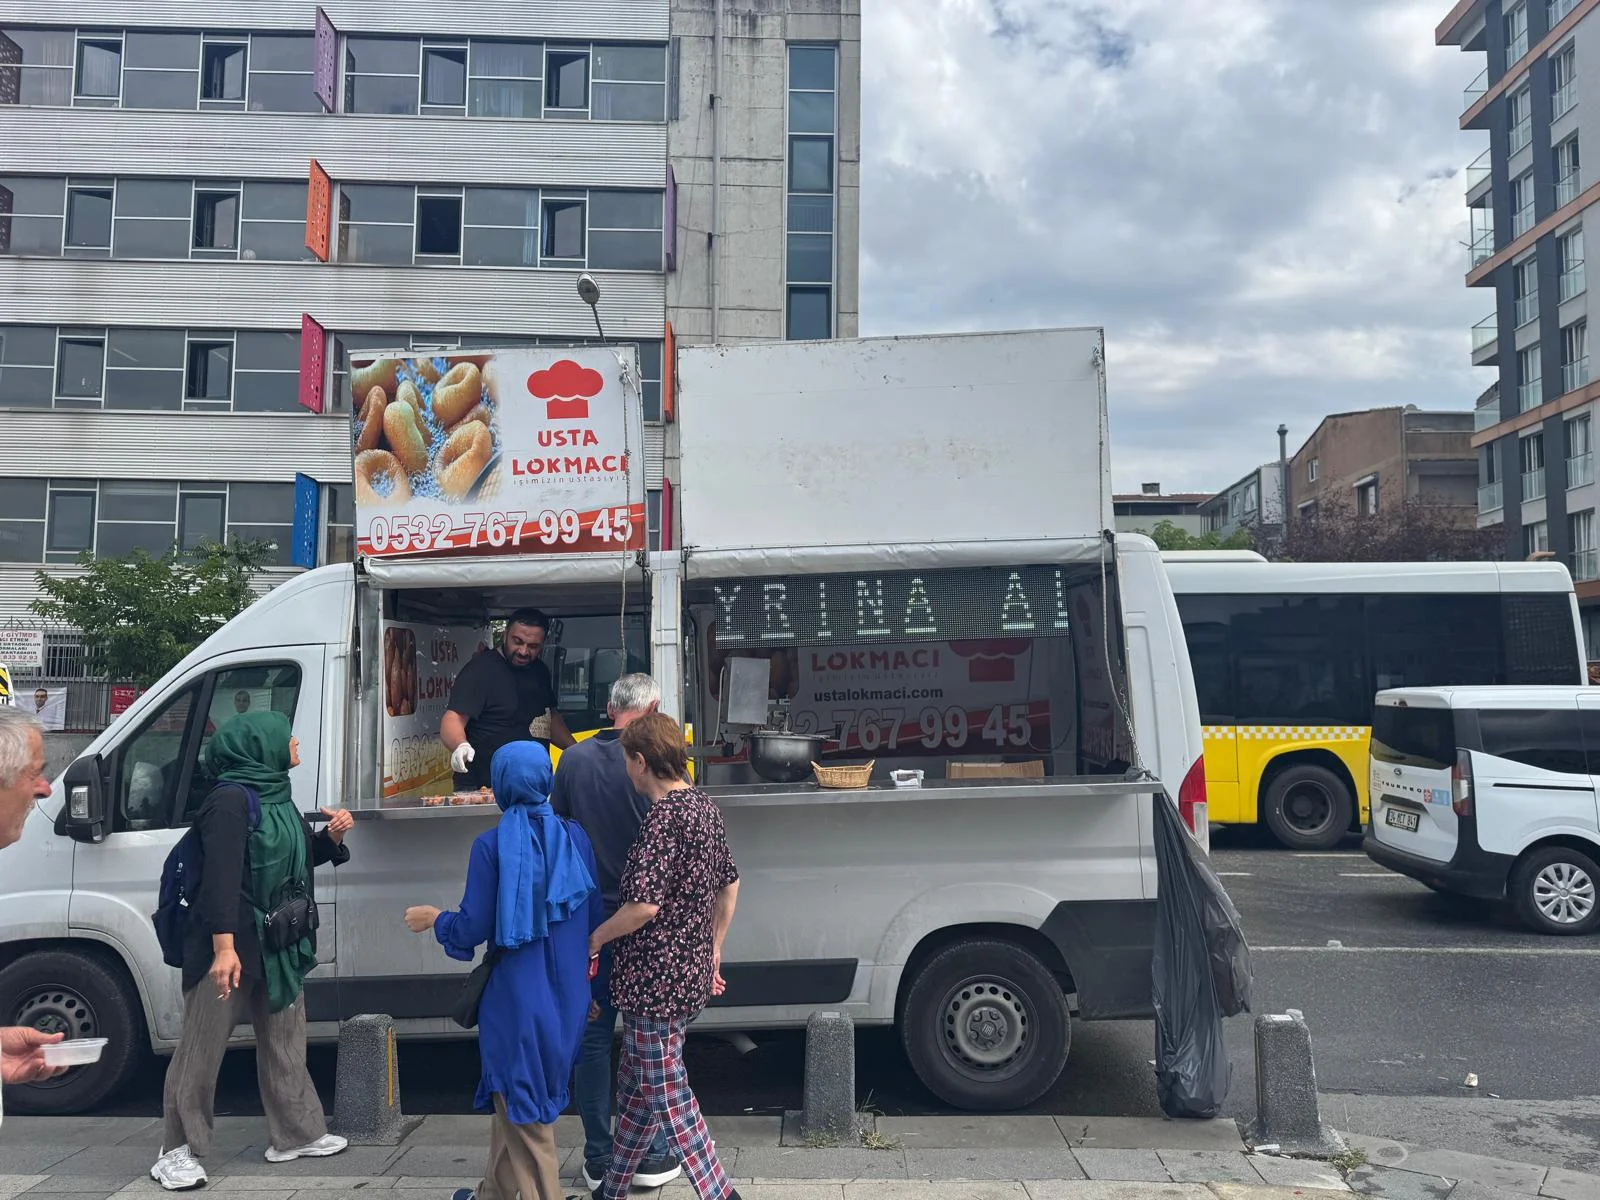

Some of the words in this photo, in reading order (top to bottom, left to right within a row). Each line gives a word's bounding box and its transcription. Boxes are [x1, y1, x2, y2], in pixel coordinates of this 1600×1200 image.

[538, 429, 599, 447] USTA
[512, 455, 628, 476] LOKMACI
[370, 516, 453, 551] 0532
[464, 511, 527, 548] 767
[539, 508, 580, 545] 99
[591, 508, 633, 542] 45
[431, 639, 459, 663] USTA
[811, 649, 940, 672] LOKMACI
[419, 676, 453, 699] LOKM
[814, 687, 943, 702] ustalokmaci.com
[832, 707, 906, 751] 767
[919, 706, 969, 749] 99
[982, 704, 1032, 746] 45
